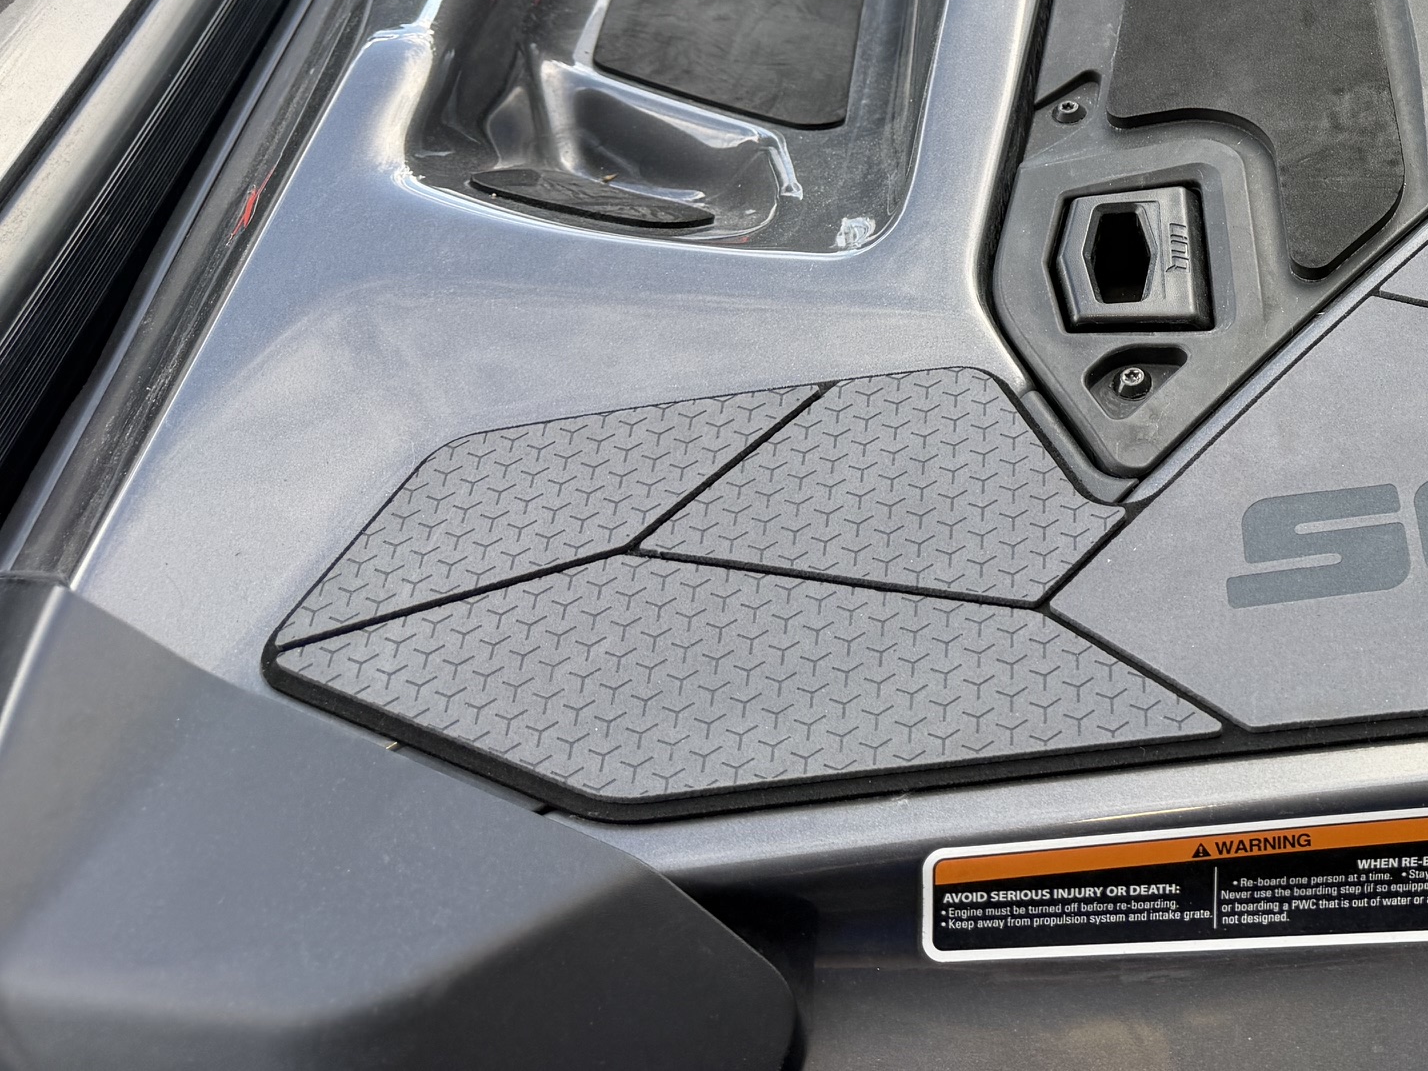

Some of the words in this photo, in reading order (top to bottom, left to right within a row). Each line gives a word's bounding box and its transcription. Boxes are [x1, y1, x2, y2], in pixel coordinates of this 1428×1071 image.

[1215, 833, 1312, 855] WARNING
[1358, 858, 1398, 869] WHEN
[1241, 877, 1286, 887] Re-board
[1311, 874, 1345, 885] person
[1360, 873, 1366, 881] a
[1369, 872, 1393, 880] time.
[944, 892, 987, 903] AVOID
[990, 890, 1050, 901] SERIOUS
[1053, 888, 1103, 899] INJURY
[1107, 886, 1126, 897] OR
[1129, 884, 1181, 895] DEATH:
[1221, 889, 1251, 899] Never
[1254, 889, 1272, 897] use
[1275, 888, 1290, 897] the
[1294, 885, 1337, 896] boarding
[1341, 884, 1361, 895] step
[1364, 883, 1374, 894] (if
[1376, 883, 1388, 892] so
[949, 907, 983, 918] Engine
[986, 905, 1010, 915] must
[1013, 904, 1026, 914] be
[1029, 903, 1061, 914] turned
[1065, 902, 1078, 912] off
[1081, 901, 1113, 912] before
[1117, 899, 1179, 911] re-boarding.
[1222, 904, 1232, 912] or
[1235, 900, 1279, 912] boarding
[1283, 902, 1288, 910] a
[1292, 899, 1316, 910] PWC
[1319, 899, 1338, 908] that
[1341, 898, 1349, 907] is
[1352, 897, 1367, 907] out
[1371, 895, 1381, 906] of
[1382, 895, 1410, 906] water
[1413, 895, 1423, 904] or
[949, 919, 974, 930] Keep
[977, 918, 1004, 928] away
[1007, 915, 1031, 926] from
[1034, 914, 1086, 926] propulsion
[1089, 911, 1125, 924] system
[1128, 911, 1147, 921] and
[1150, 910, 1180, 920] intake
[1183, 909, 1213, 920] grate.
[1223, 915, 1238, 924] not
[1242, 912, 1289, 925] designed.
